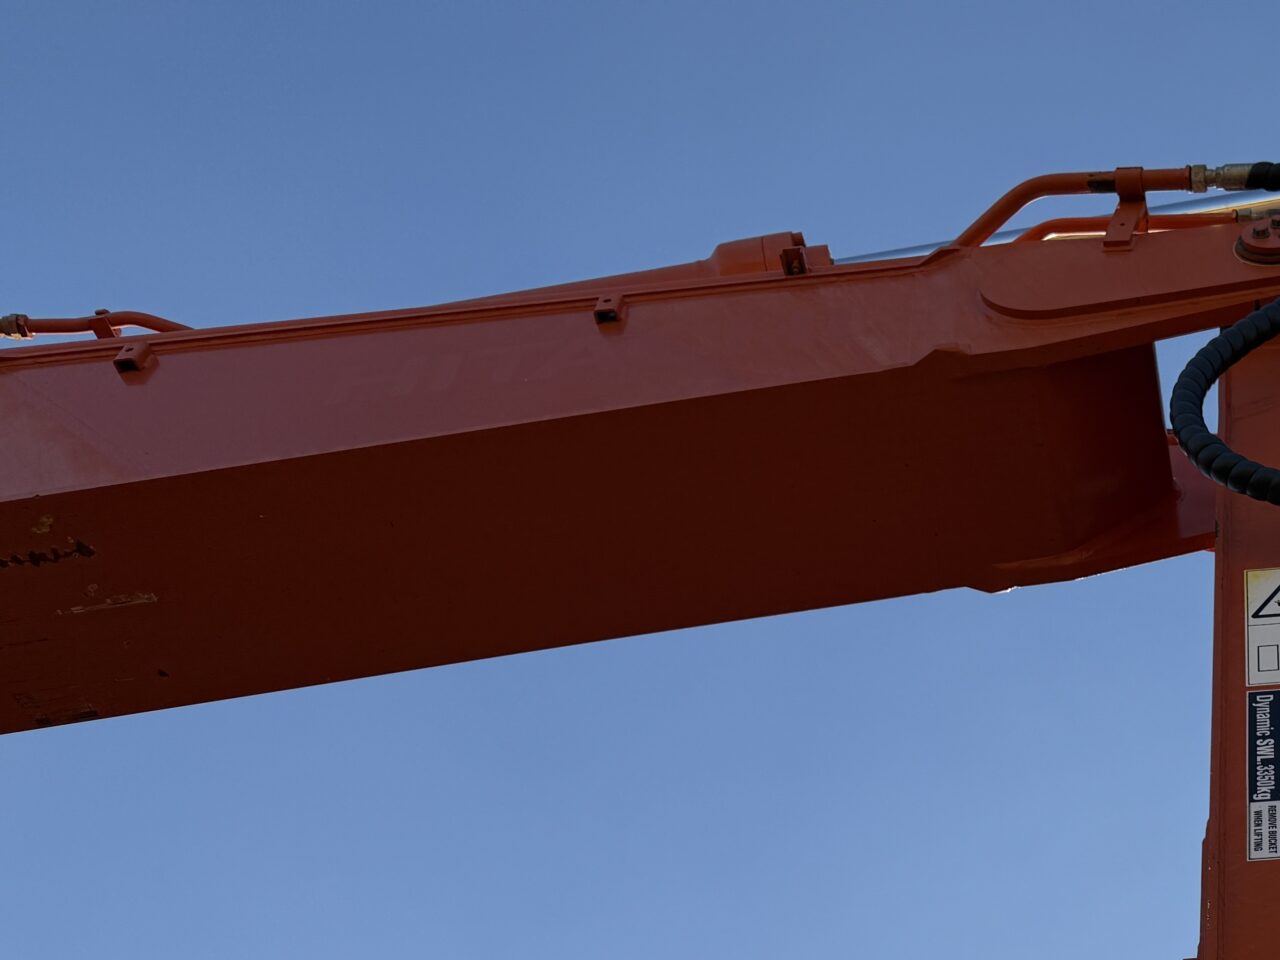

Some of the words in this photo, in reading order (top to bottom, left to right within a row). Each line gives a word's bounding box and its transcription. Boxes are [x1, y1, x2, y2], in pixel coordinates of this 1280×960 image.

[1253, 695, 1274, 736] Dynamic
[1254, 810, 1262, 827] WHEN
[1268, 805, 1277, 829] REMOVE
[1254, 829, 1262, 851] LIFTING
[1269, 831, 1277, 853] BUCKET
